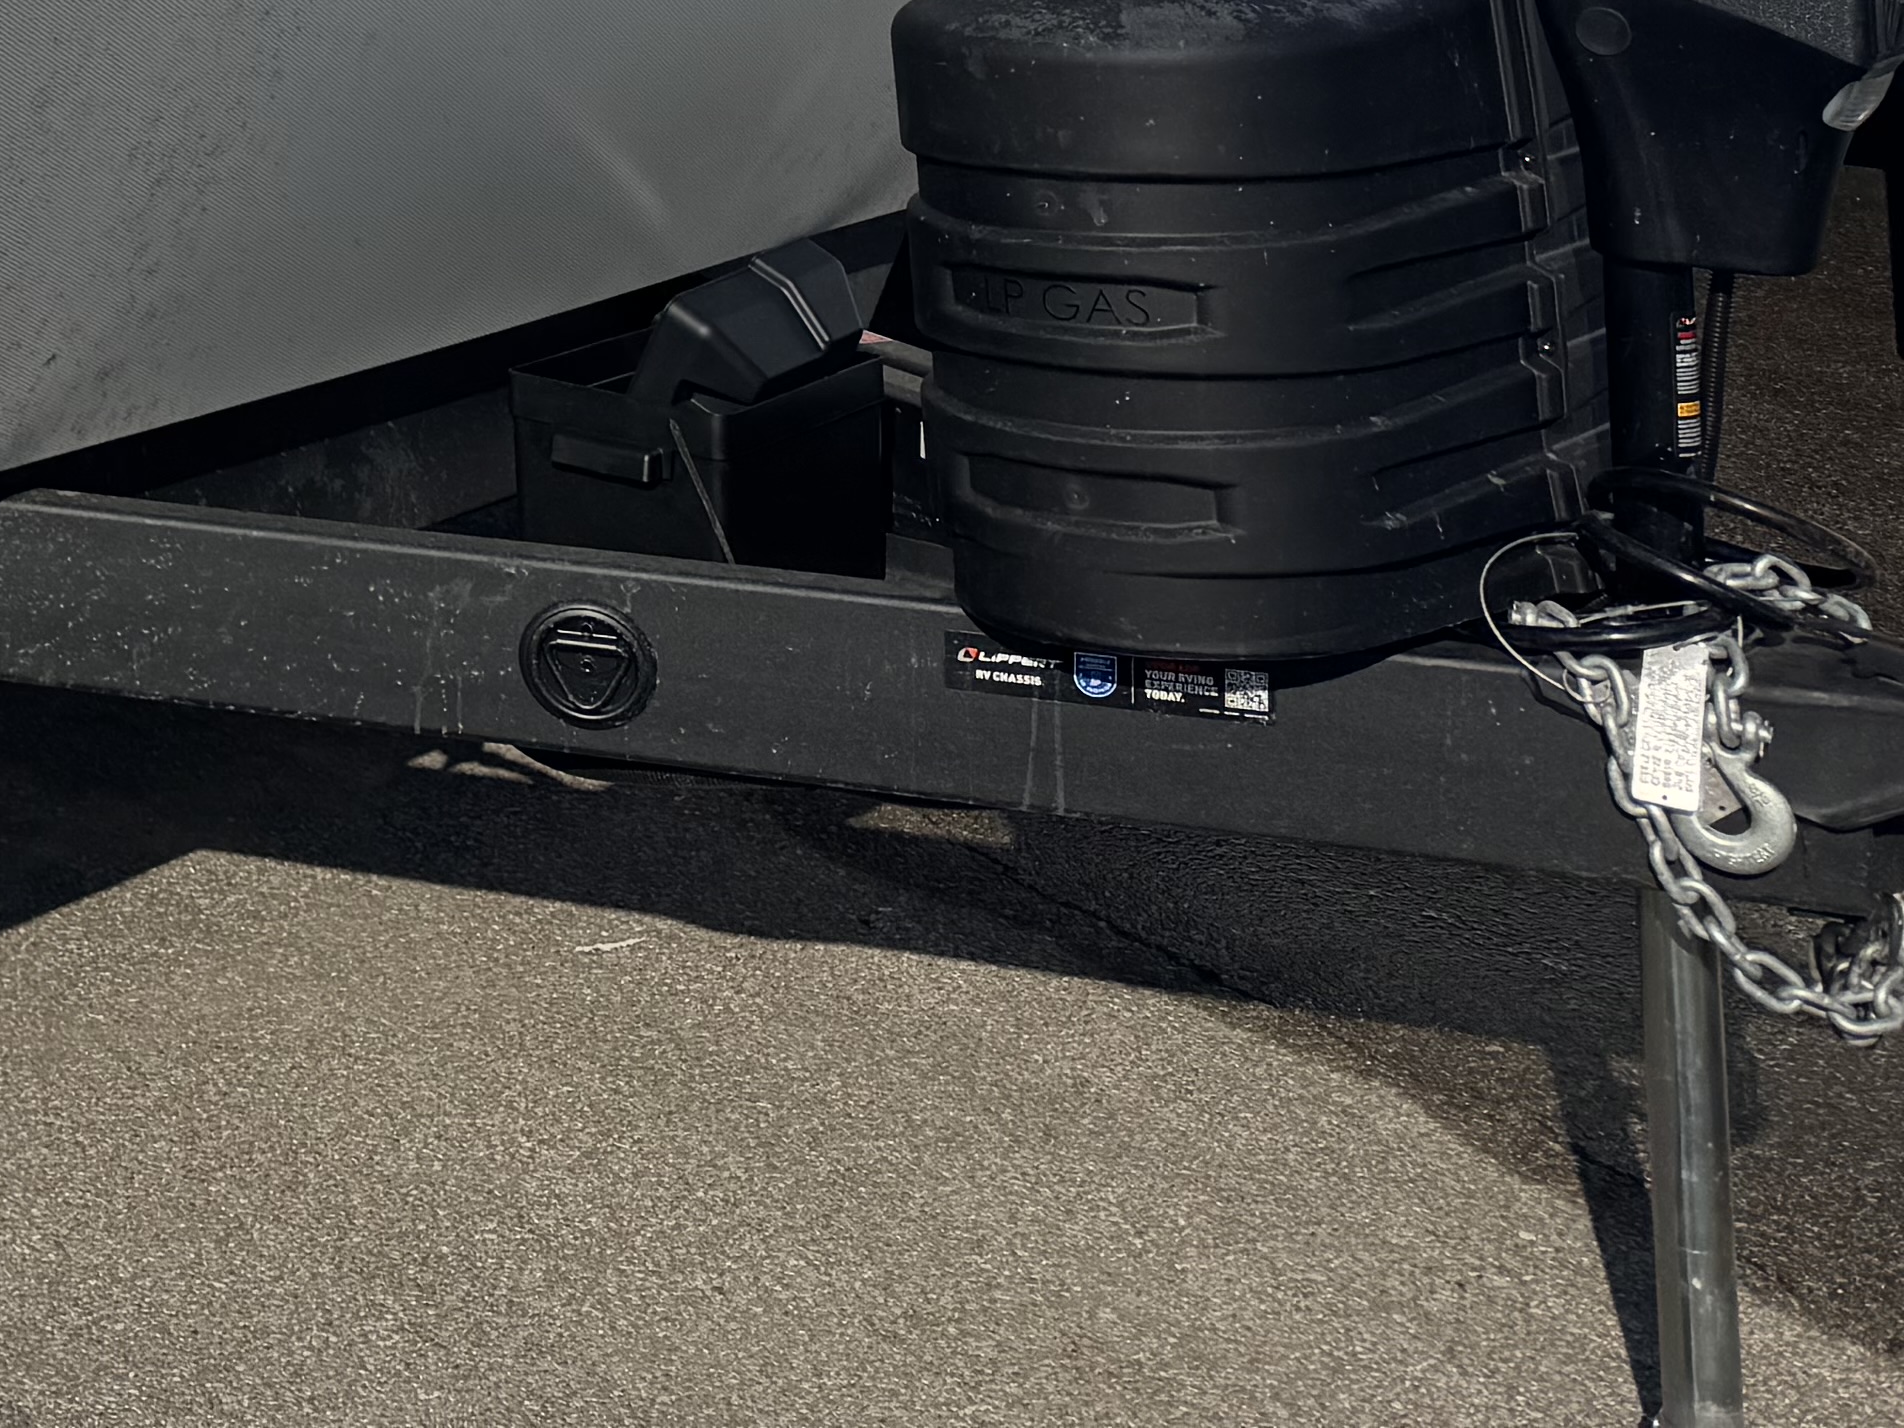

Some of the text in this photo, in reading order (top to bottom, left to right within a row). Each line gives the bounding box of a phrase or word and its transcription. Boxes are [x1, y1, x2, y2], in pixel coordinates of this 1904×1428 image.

[984, 276, 1150, 327] LP GAS
[975, 669, 991, 681] RV
[1144, 669, 1176, 681] YOUR
[1144, 679, 1219, 697] EXPERIENCE
[1144, 689, 1186, 703] TODAY.
